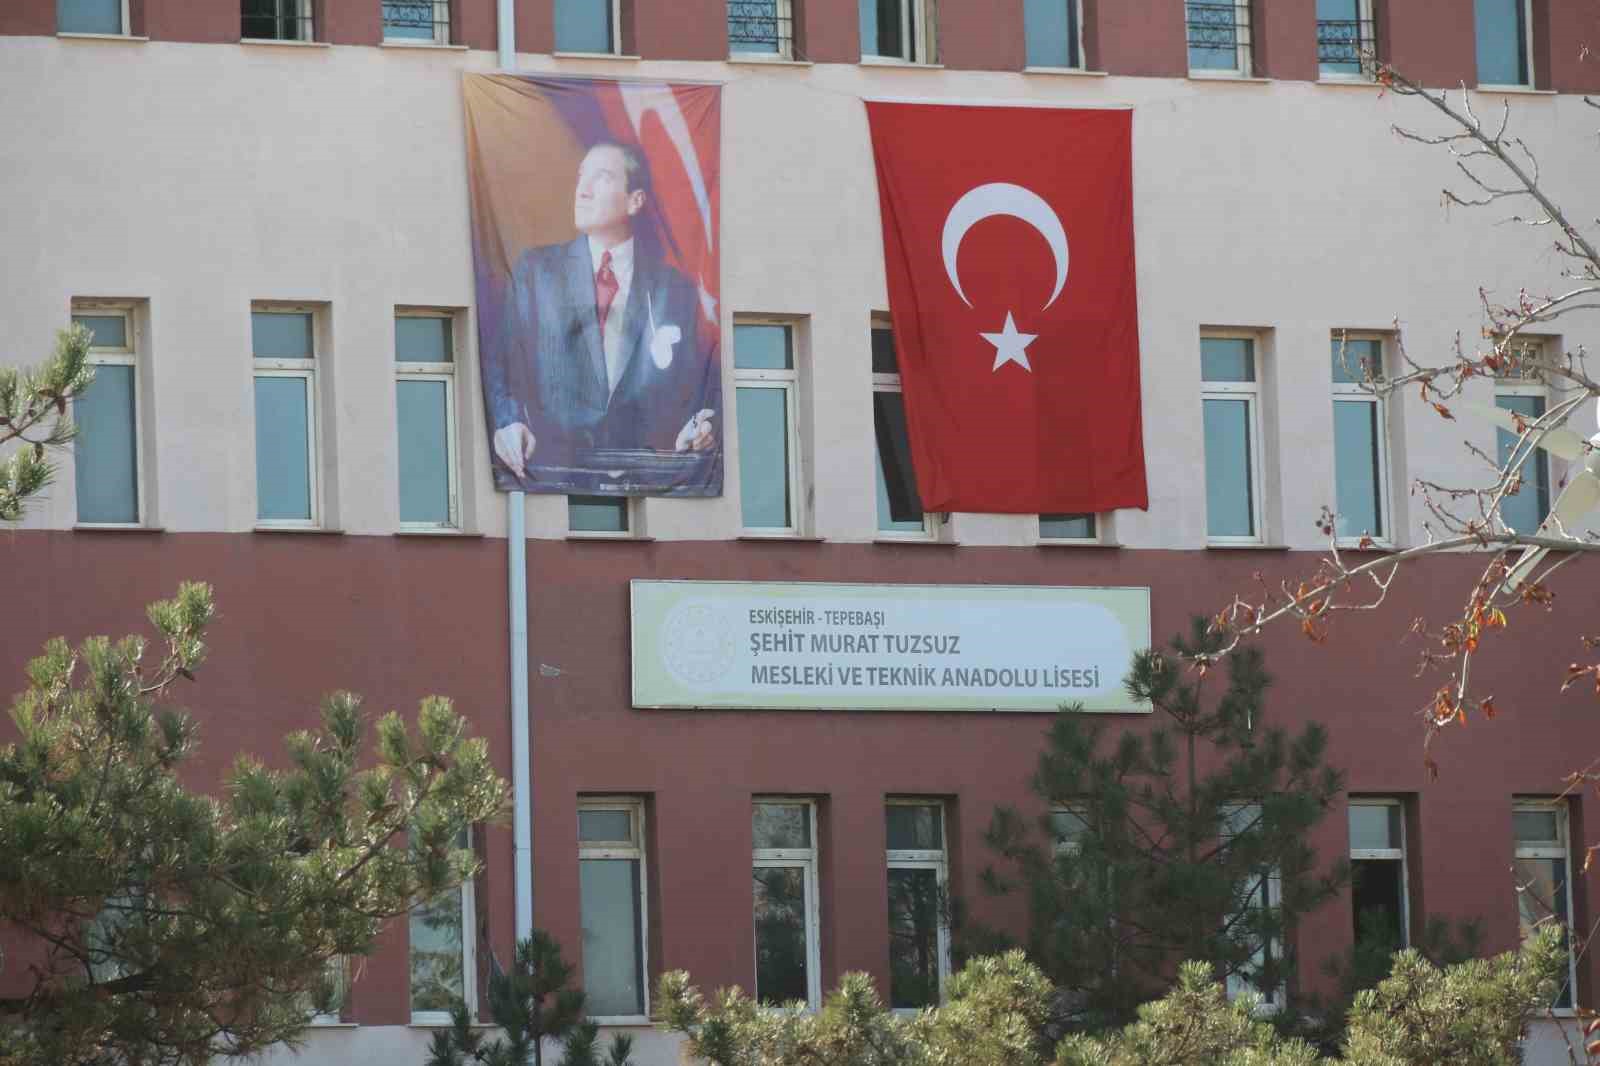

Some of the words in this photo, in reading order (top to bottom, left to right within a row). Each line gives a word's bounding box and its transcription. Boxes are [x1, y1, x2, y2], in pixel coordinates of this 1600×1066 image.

[749, 607, 815, 628] ESKİŞEHİR
[824, 610, 885, 629] TEPEBAŞI
[750, 630, 806, 657] ŞEHİT
[810, 634, 880, 654] MURAT
[882, 634, 961, 655] TUZSUZ
[751, 663, 833, 686] MESLEKİ
[837, 666, 863, 686] VE
[865, 664, 937, 687] TEKNİK
[941, 667, 1038, 688] ANADOLU
[1042, 666, 1100, 689] LİSESİ
